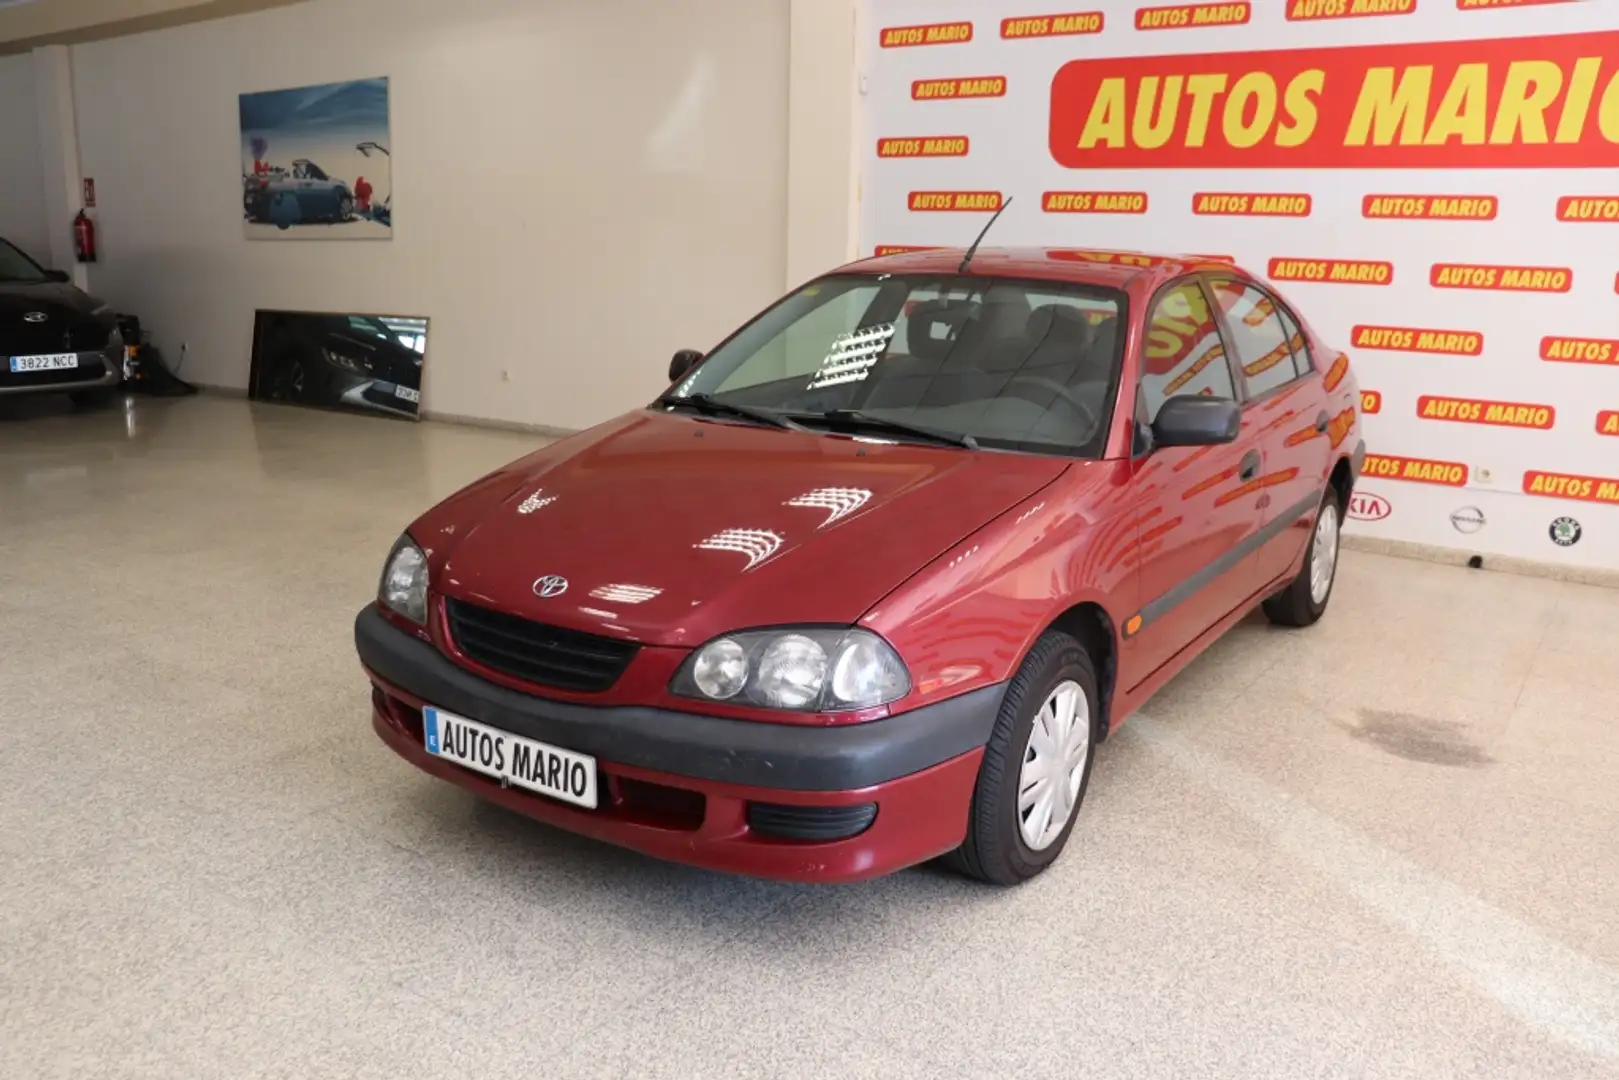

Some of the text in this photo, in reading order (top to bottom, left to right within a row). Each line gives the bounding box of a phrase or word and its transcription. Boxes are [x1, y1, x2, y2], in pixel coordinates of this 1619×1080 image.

[1141, 4, 1245, 26] AUTOS MARIO
[885, 25, 969, 44] AUTOS MARIO
[1006, 15, 1100, 35] AUTOS MARIO
[917, 79, 1002, 97] AUTOS MARIO
[1078, 69, 1325, 149] AUTOS
[882, 139, 965, 154] AUTOS MARIO
[914, 194, 998, 208] AUTOS MARIO
[1048, 195, 1143, 210] AUTOS MARIO
[1199, 196, 1306, 213] AUTOS MARIO
[1370, 198, 1492, 216] AUTOS MARIO
[1564, 200, 1619, 218] AUTO
[1275, 262, 1388, 281] AUTOS MARIO
[1438, 267, 1566, 288] AUTOS MARIO
[1358, 329, 1478, 351] AUTOS MARIO
[1548, 341, 1609, 360] AUTOS
[20, 358, 49, 369] 3822
[1424, 400, 1549, 425] AUTOS MARIO
[1404, 462, 1462, 483] MARIO
[1531, 475, 1591, 496] AUTOS
[443, 720, 587, 797] AUTOS MARIO
